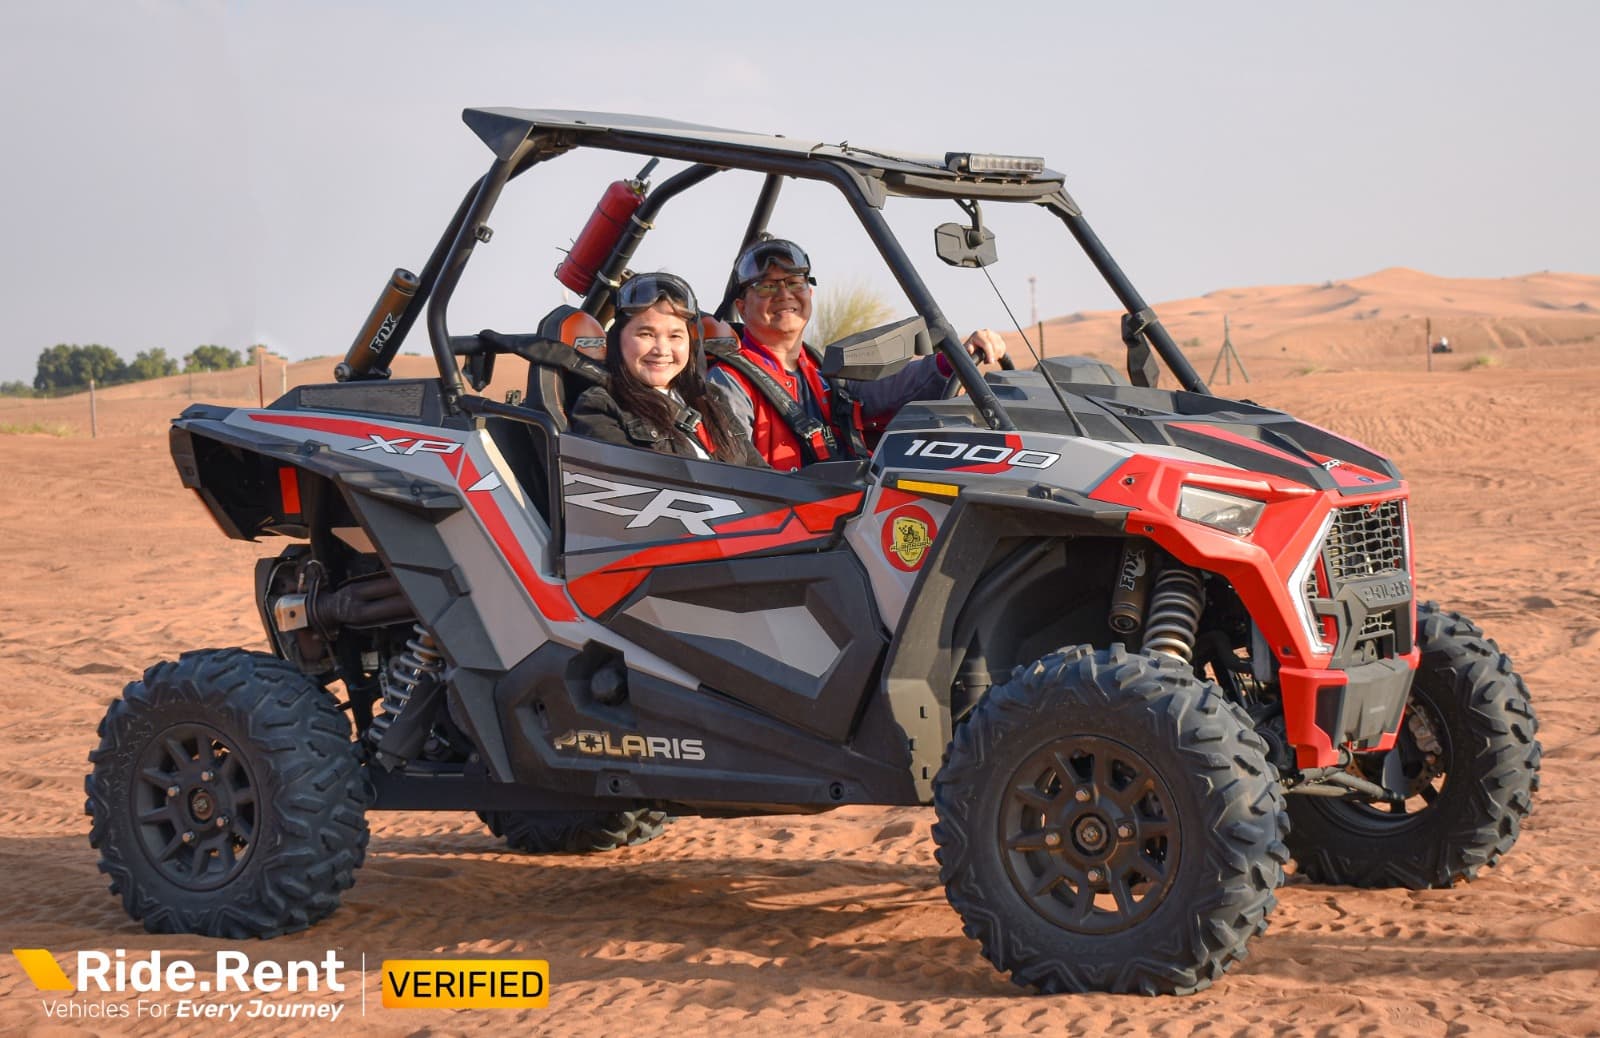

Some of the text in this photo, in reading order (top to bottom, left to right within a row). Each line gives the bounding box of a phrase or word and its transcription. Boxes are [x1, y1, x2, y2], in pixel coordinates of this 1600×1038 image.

[369, 313, 401, 354] FOX
[354, 435, 464, 455] XP
[904, 439, 1062, 469] 1000
[1119, 550, 1144, 591] FOX
[554, 729, 706, 761] POLARIS
